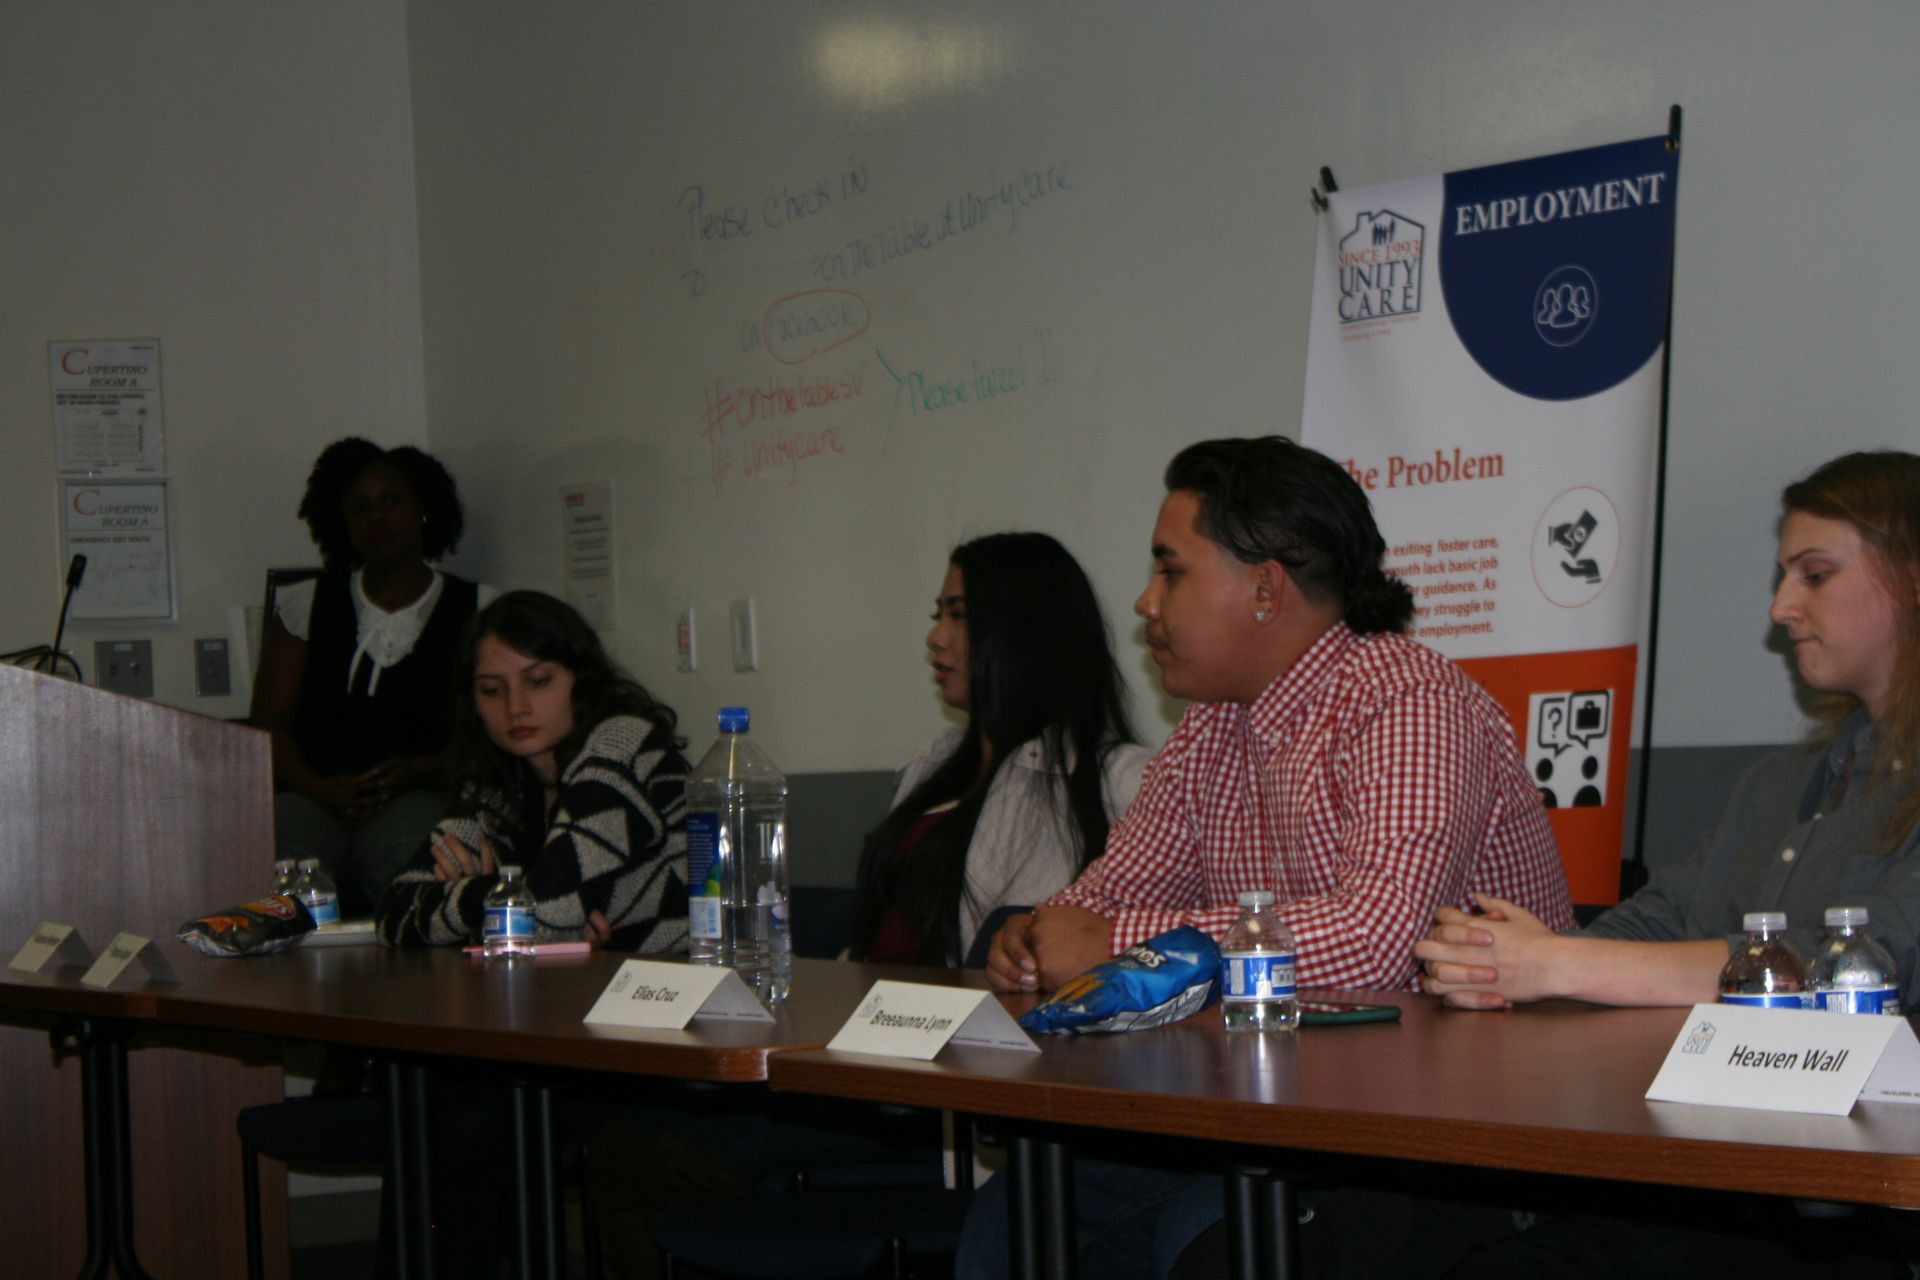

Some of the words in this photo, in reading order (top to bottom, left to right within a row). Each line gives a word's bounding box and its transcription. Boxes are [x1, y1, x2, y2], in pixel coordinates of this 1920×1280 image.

[675, 184, 752, 241] Please
[1455, 172, 1666, 236] EMPLOYMENT
[1338, 248, 1380, 268] SINCE
[1386, 240, 1420, 261] 1993
[1338, 257, 1419, 295] UNITY
[1338, 286, 1414, 321] CARE
[60, 347, 148, 376] CUPERTINO
[89, 378, 126, 388] ROOM
[128, 378, 138, 387] A
[1386, 448, 1505, 490] Problem
[73, 489, 159, 516] CUPERTINO
[101, 518, 138, 528] ROOM
[140, 518, 150, 527] A
[1393, 543, 1433, 558] exiting
[1437, 538, 1470, 554] foster
[1423, 560, 1446, 575] lack
[1448, 557, 1478, 573] basic
[1480, 555, 1499, 572] job
[1483, 577, 1497, 591] As
[1434, 599, 1481, 618] struggle
[1484, 599, 1496, 613] to
[632, 985, 656, 1001] Elias
[655, 986, 680, 1002] Cruz
[869, 1009, 926, 1030] Breeaunna
[924, 1013, 953, 1034] Lynn
[1728, 1044, 1798, 1071] Heaven
[1801, 1049, 1850, 1073] Wall
